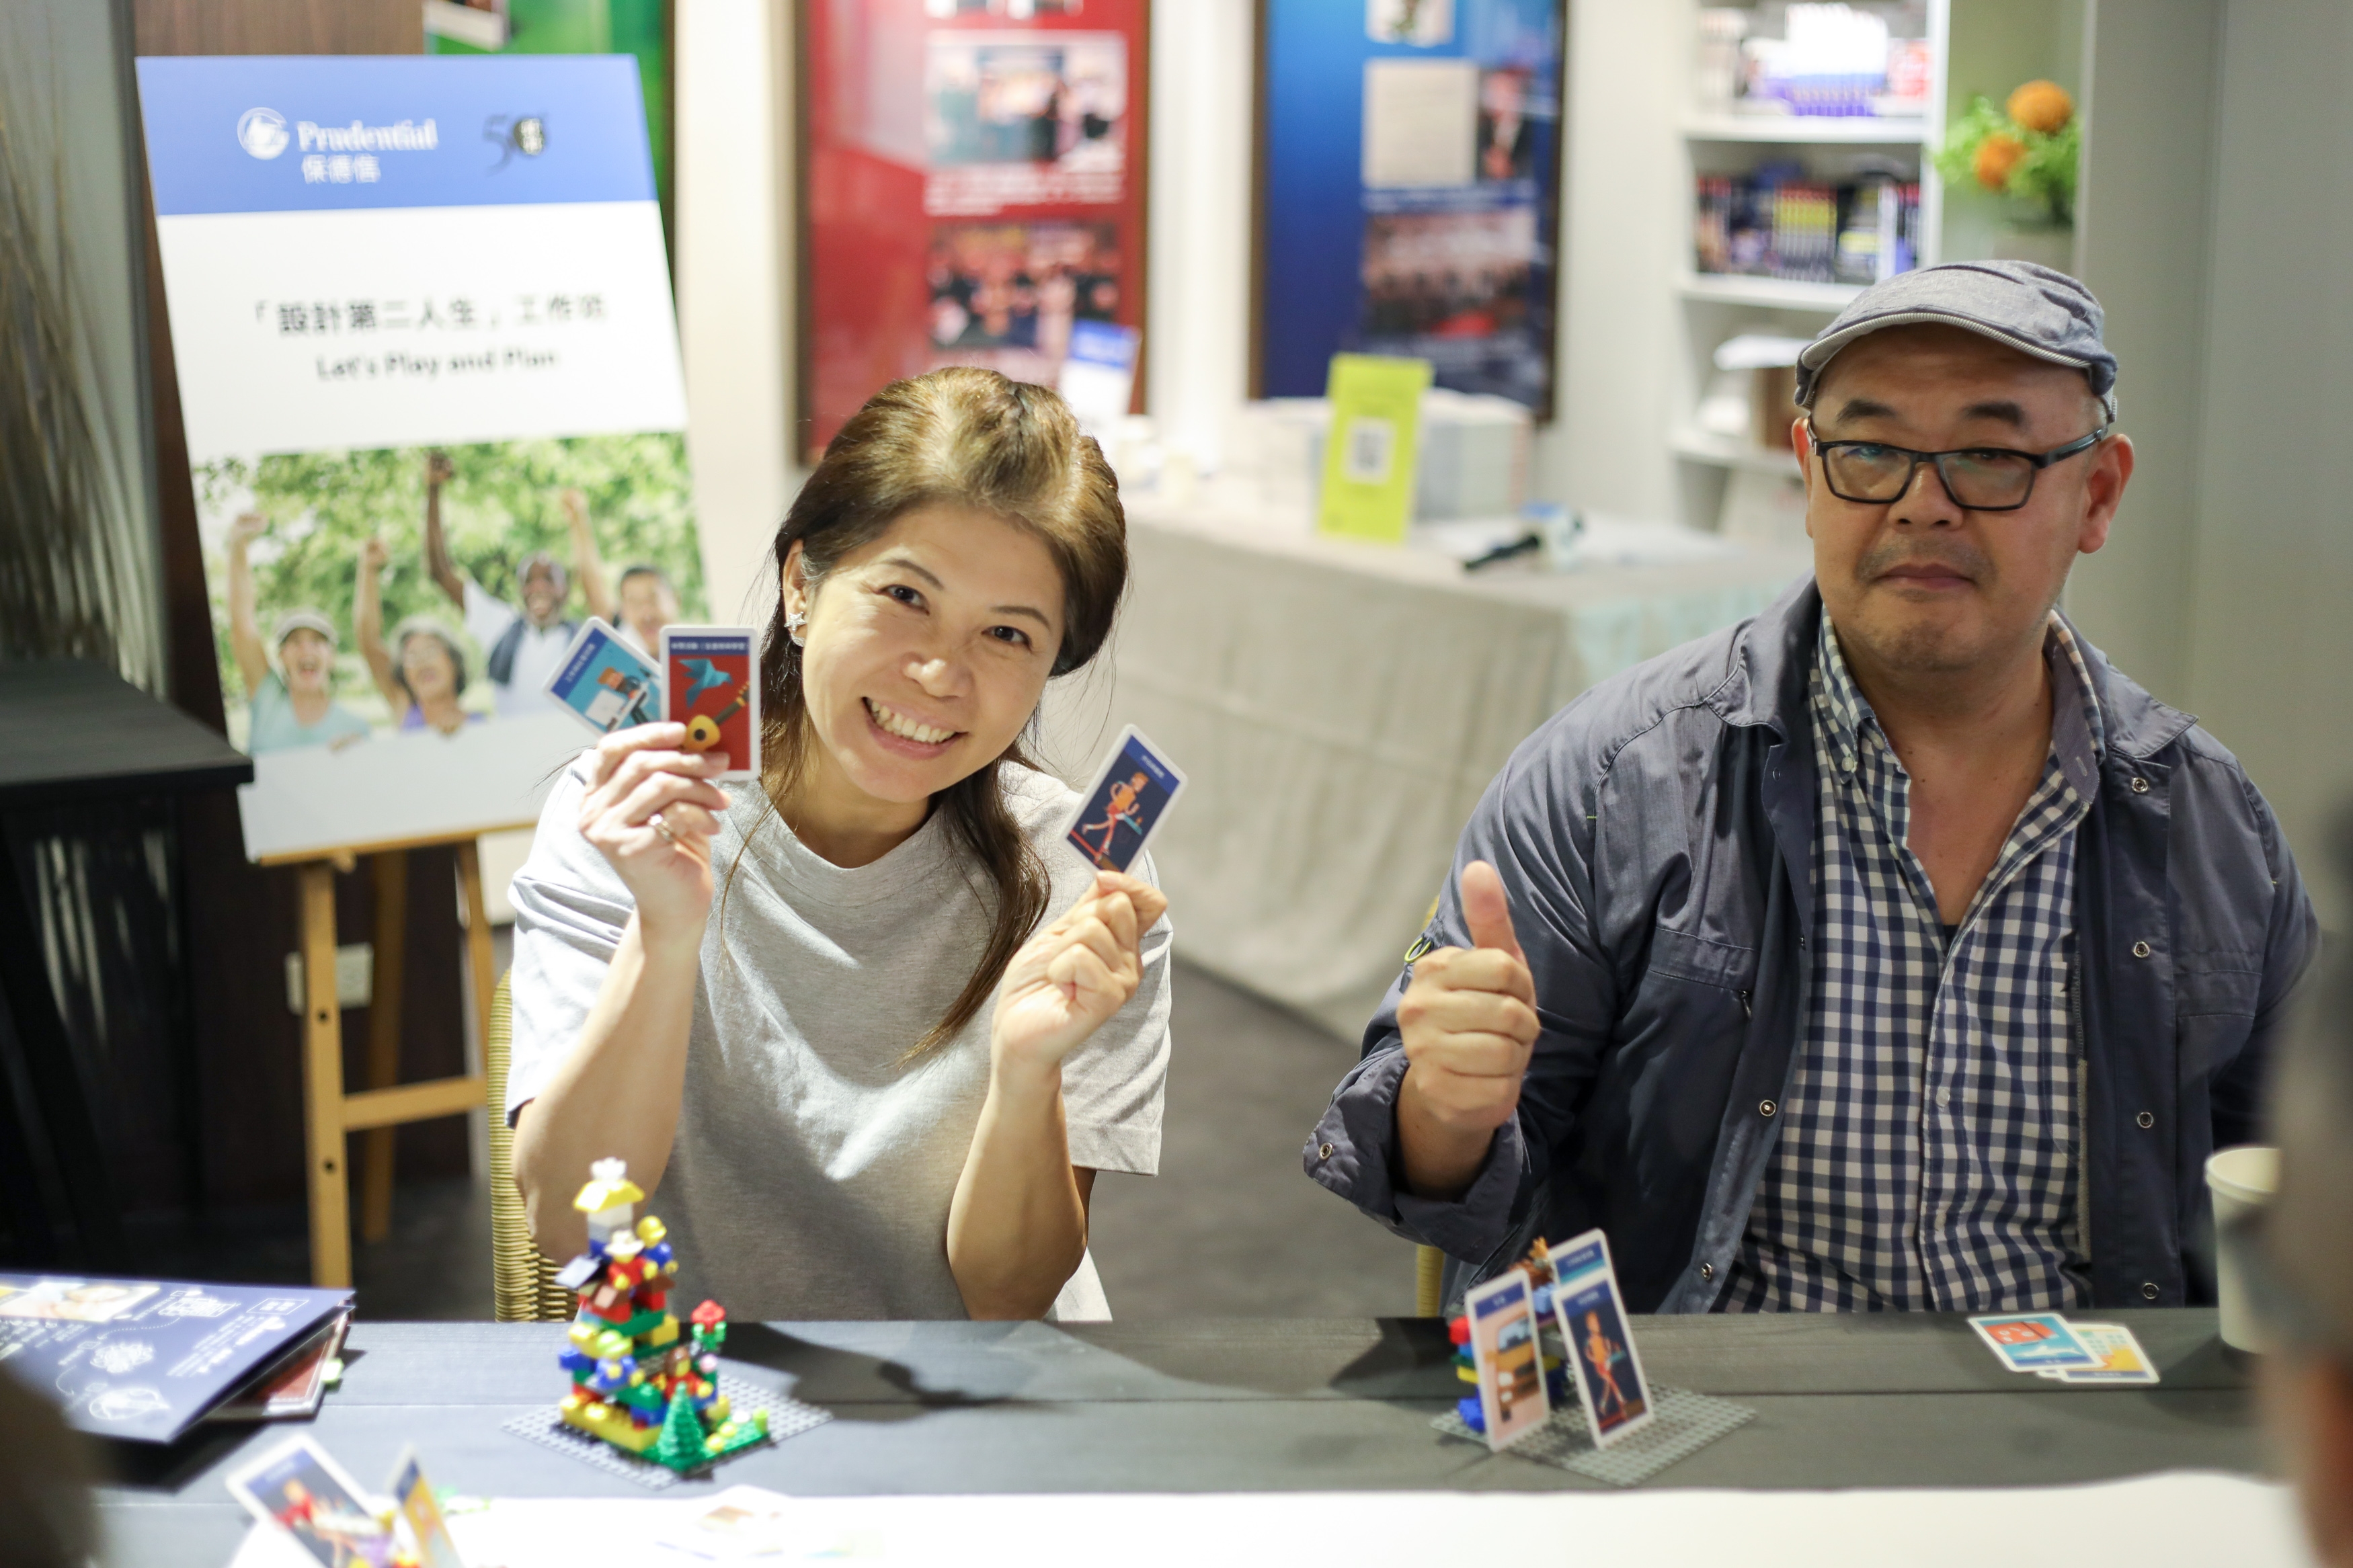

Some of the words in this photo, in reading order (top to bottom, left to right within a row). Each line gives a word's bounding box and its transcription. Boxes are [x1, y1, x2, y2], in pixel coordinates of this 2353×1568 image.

[296, 118, 438, 152] Prudential
[383, 350, 440, 382] Play
[448, 351, 496, 374] and
[504, 345, 559, 368] Plan
